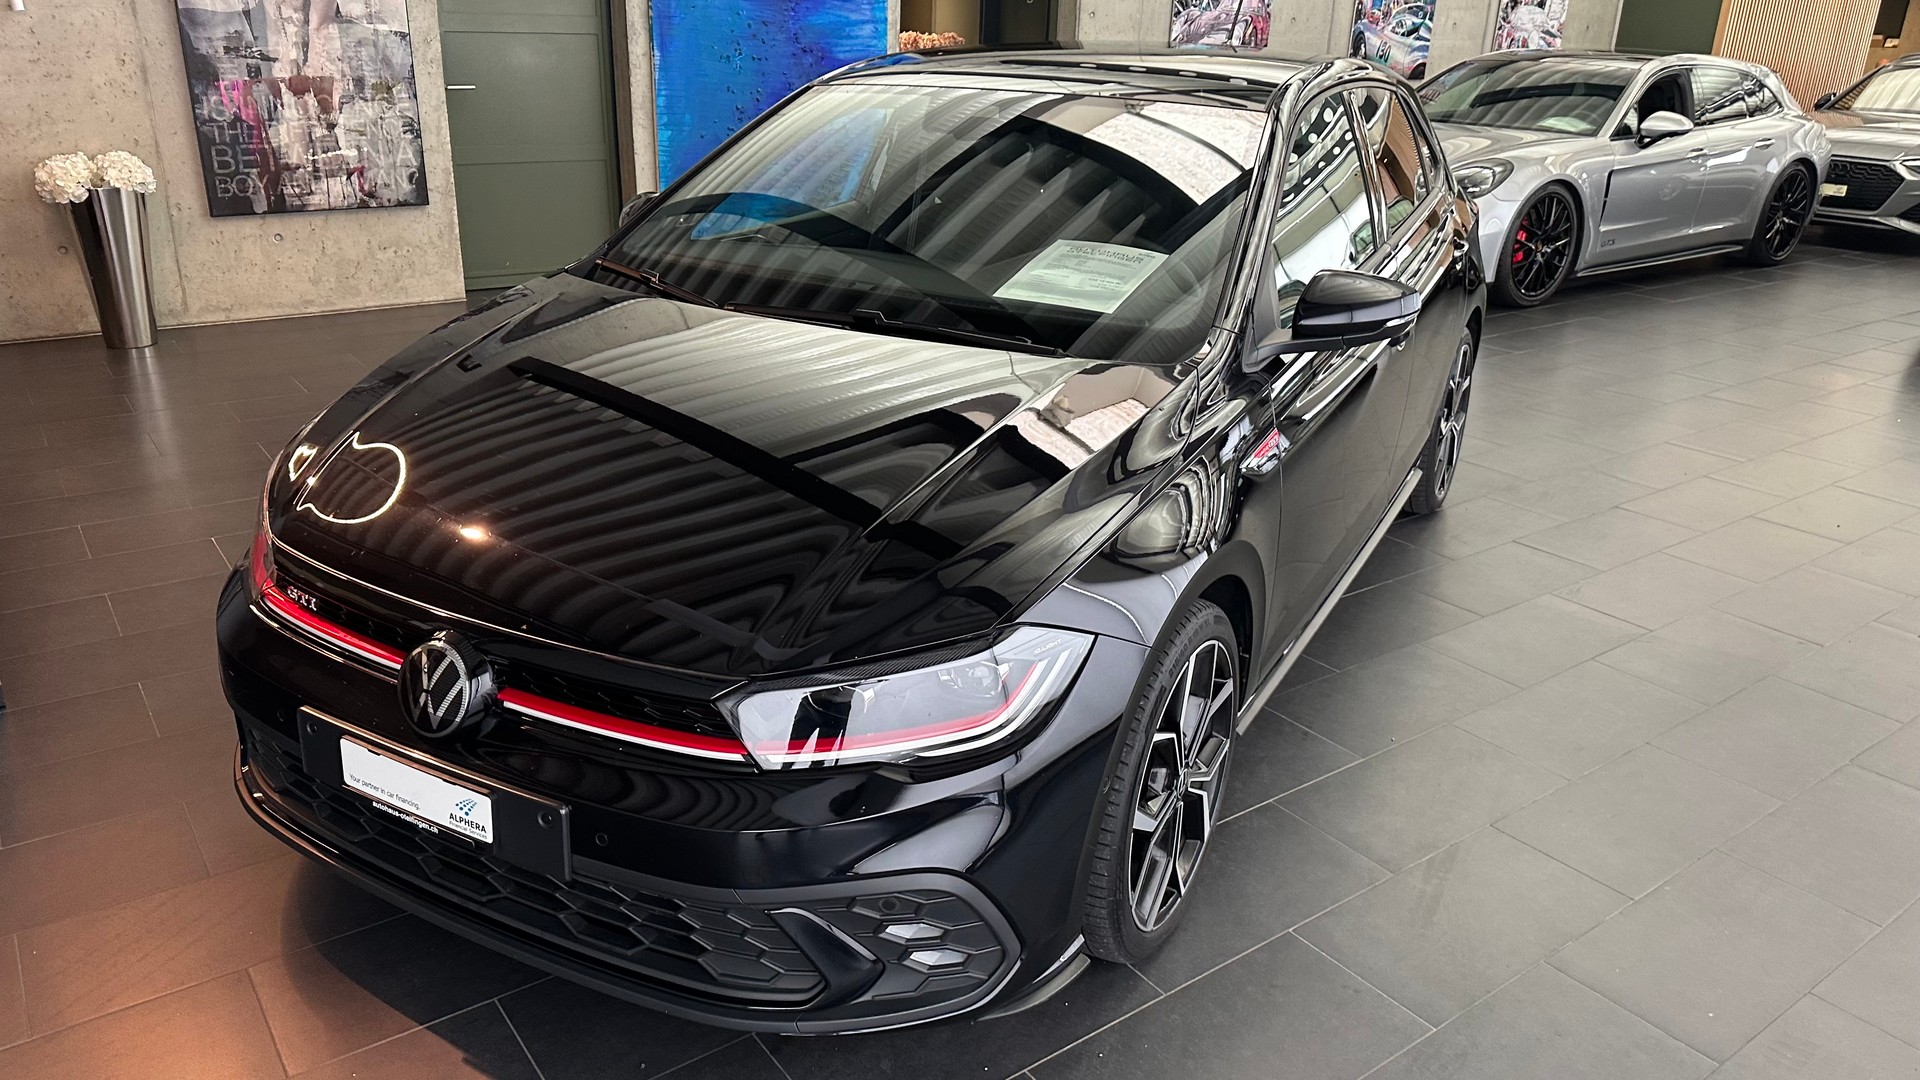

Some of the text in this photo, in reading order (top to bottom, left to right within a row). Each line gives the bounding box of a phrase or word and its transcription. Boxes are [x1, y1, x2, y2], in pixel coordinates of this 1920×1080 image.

[206, 120, 260, 144] THE
[214, 173, 269, 198] BOY
[287, 585, 317, 611] GTI
[349, 773, 361, 784] Your
[362, 780, 380, 792] partner
[380, 787, 386, 795] in
[386, 791, 395, 799] car
[448, 820, 488, 840] Financial Services
[449, 812, 487, 834] ALPHERA
